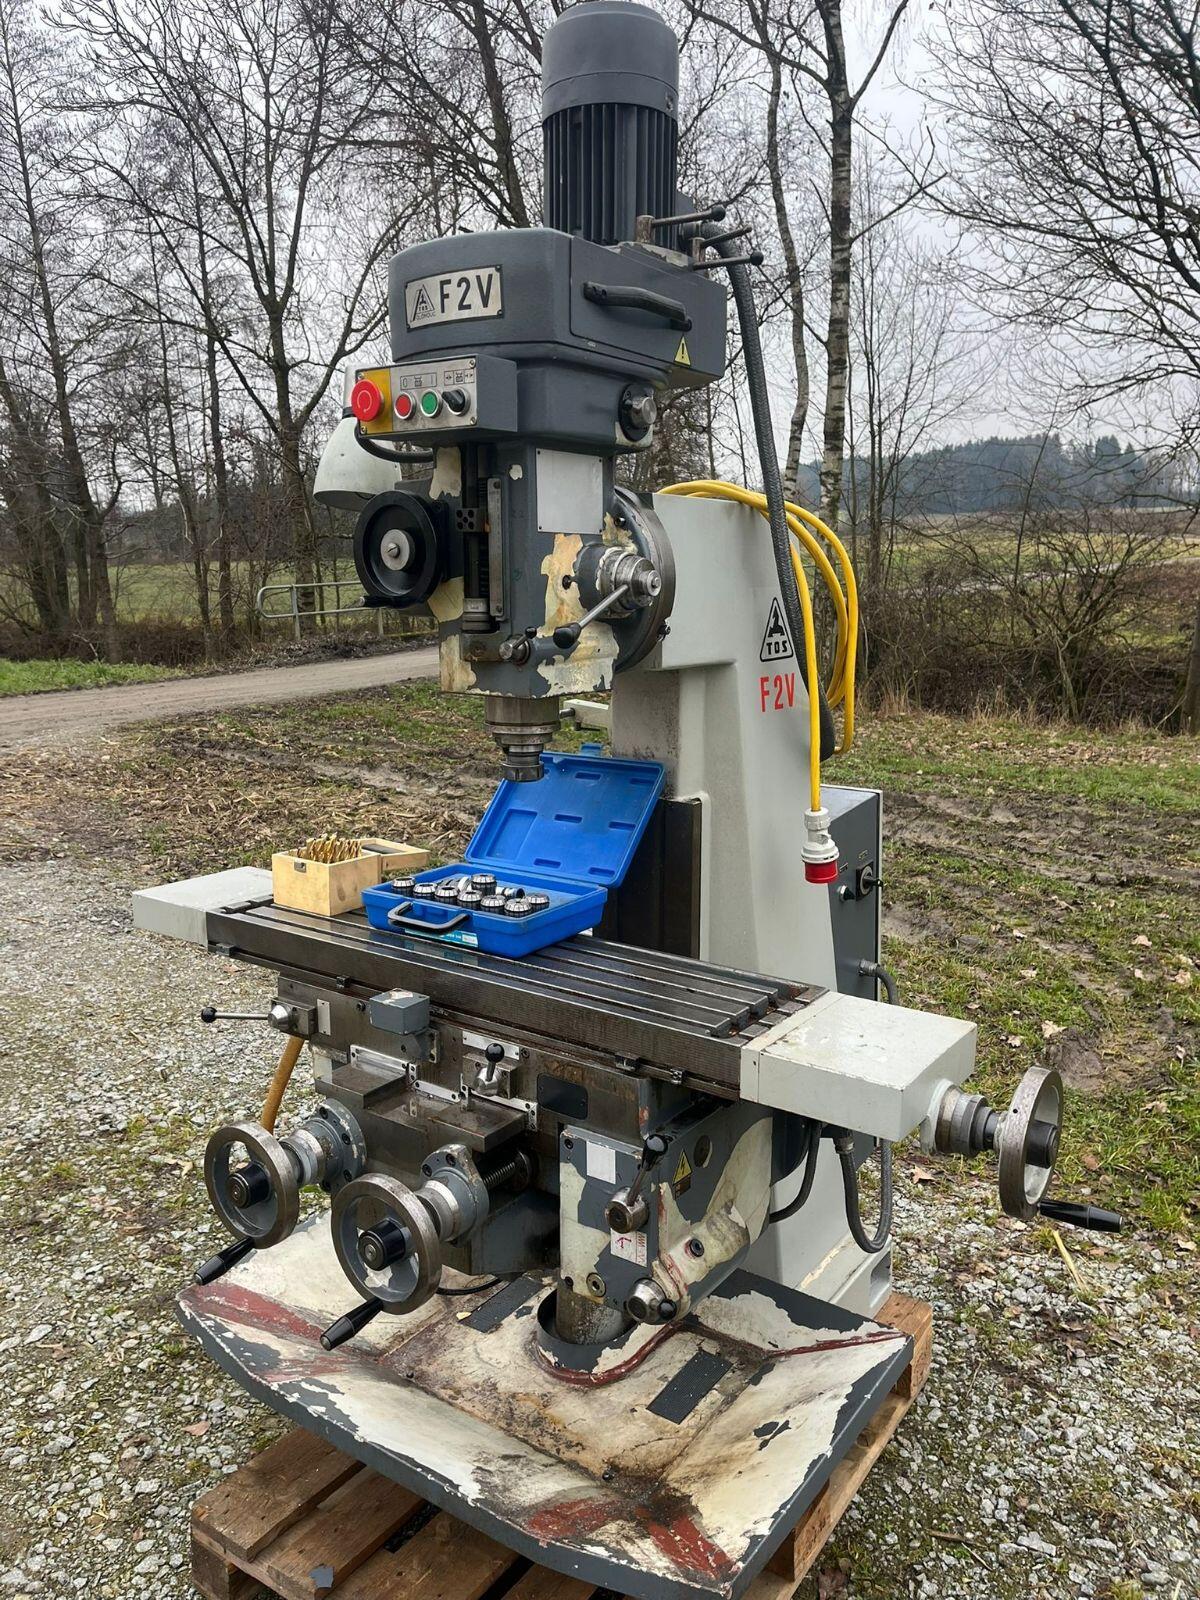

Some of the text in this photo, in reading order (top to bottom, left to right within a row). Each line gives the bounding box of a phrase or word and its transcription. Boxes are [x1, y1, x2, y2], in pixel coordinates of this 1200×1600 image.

[439, 273, 493, 313] F2V
[766, 640, 788, 655] TOS
[760, 672, 795, 712] F2V
